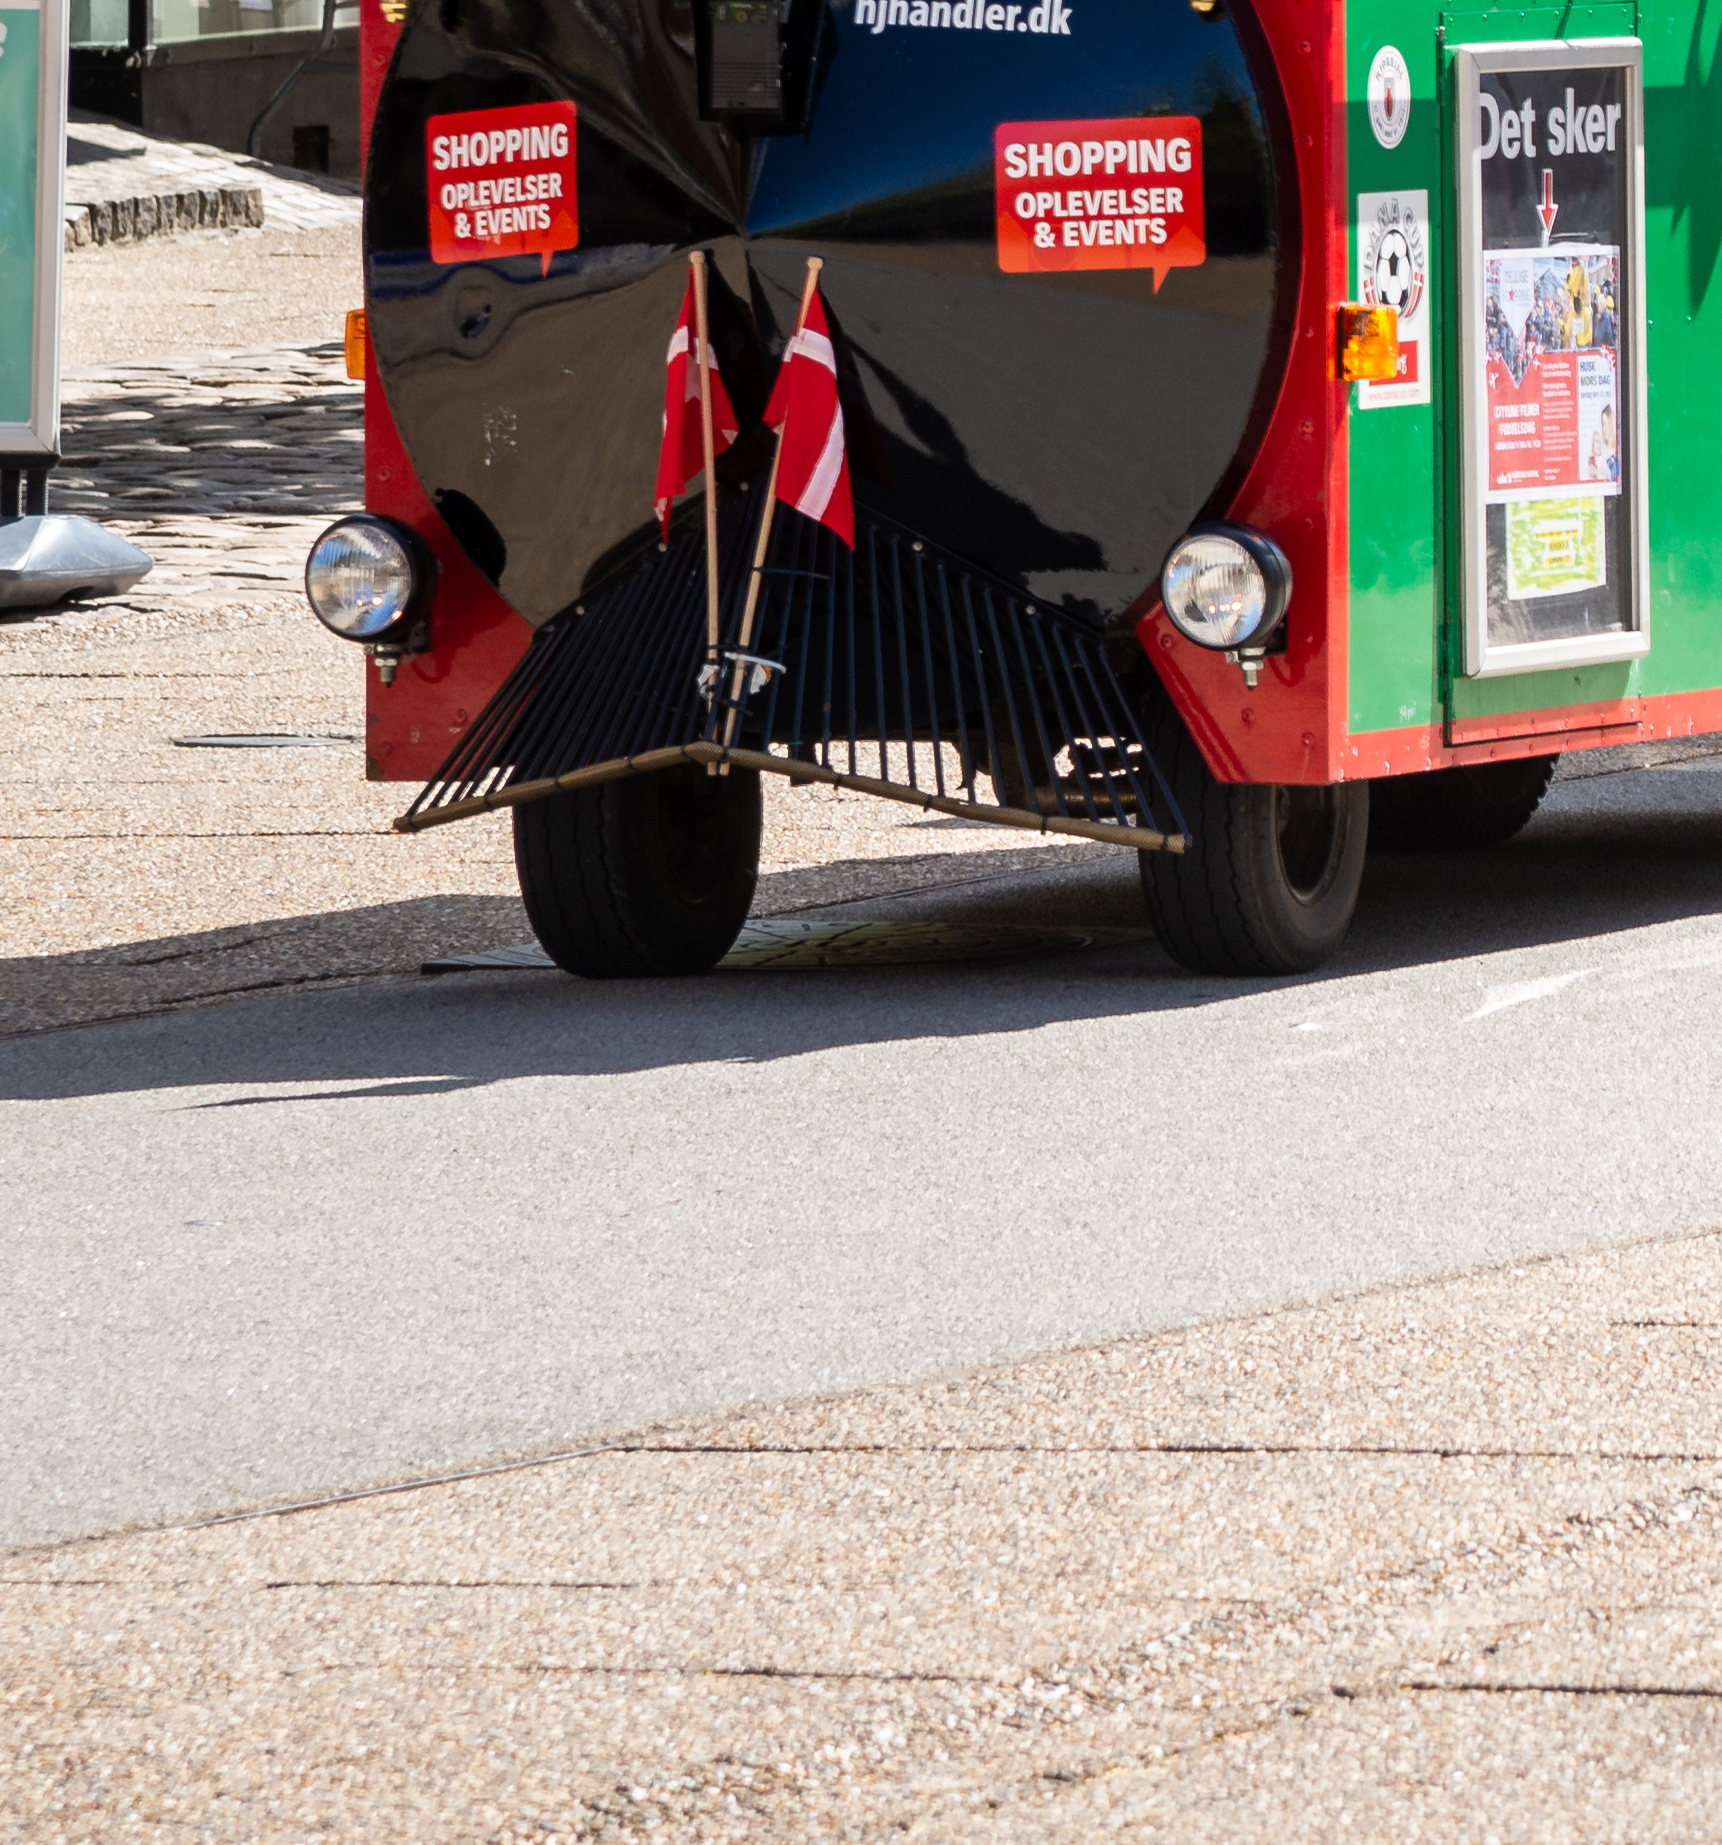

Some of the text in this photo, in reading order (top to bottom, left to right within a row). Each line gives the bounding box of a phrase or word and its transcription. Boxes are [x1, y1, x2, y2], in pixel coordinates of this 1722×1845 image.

[1480, 92, 1536, 159] Det
[1547, 88, 1621, 156] sker
[433, 123, 570, 170] SHOPPING
[1005, 137, 1192, 176] SHOPPING
[441, 172, 563, 211] OPLEVELSER
[1015, 188, 1184, 219] OPLEVELSER
[454, 204, 551, 239] & EVENTS
[1034, 218, 1169, 247] & EVENTS
[1364, 198, 1425, 271] DANA CUP
